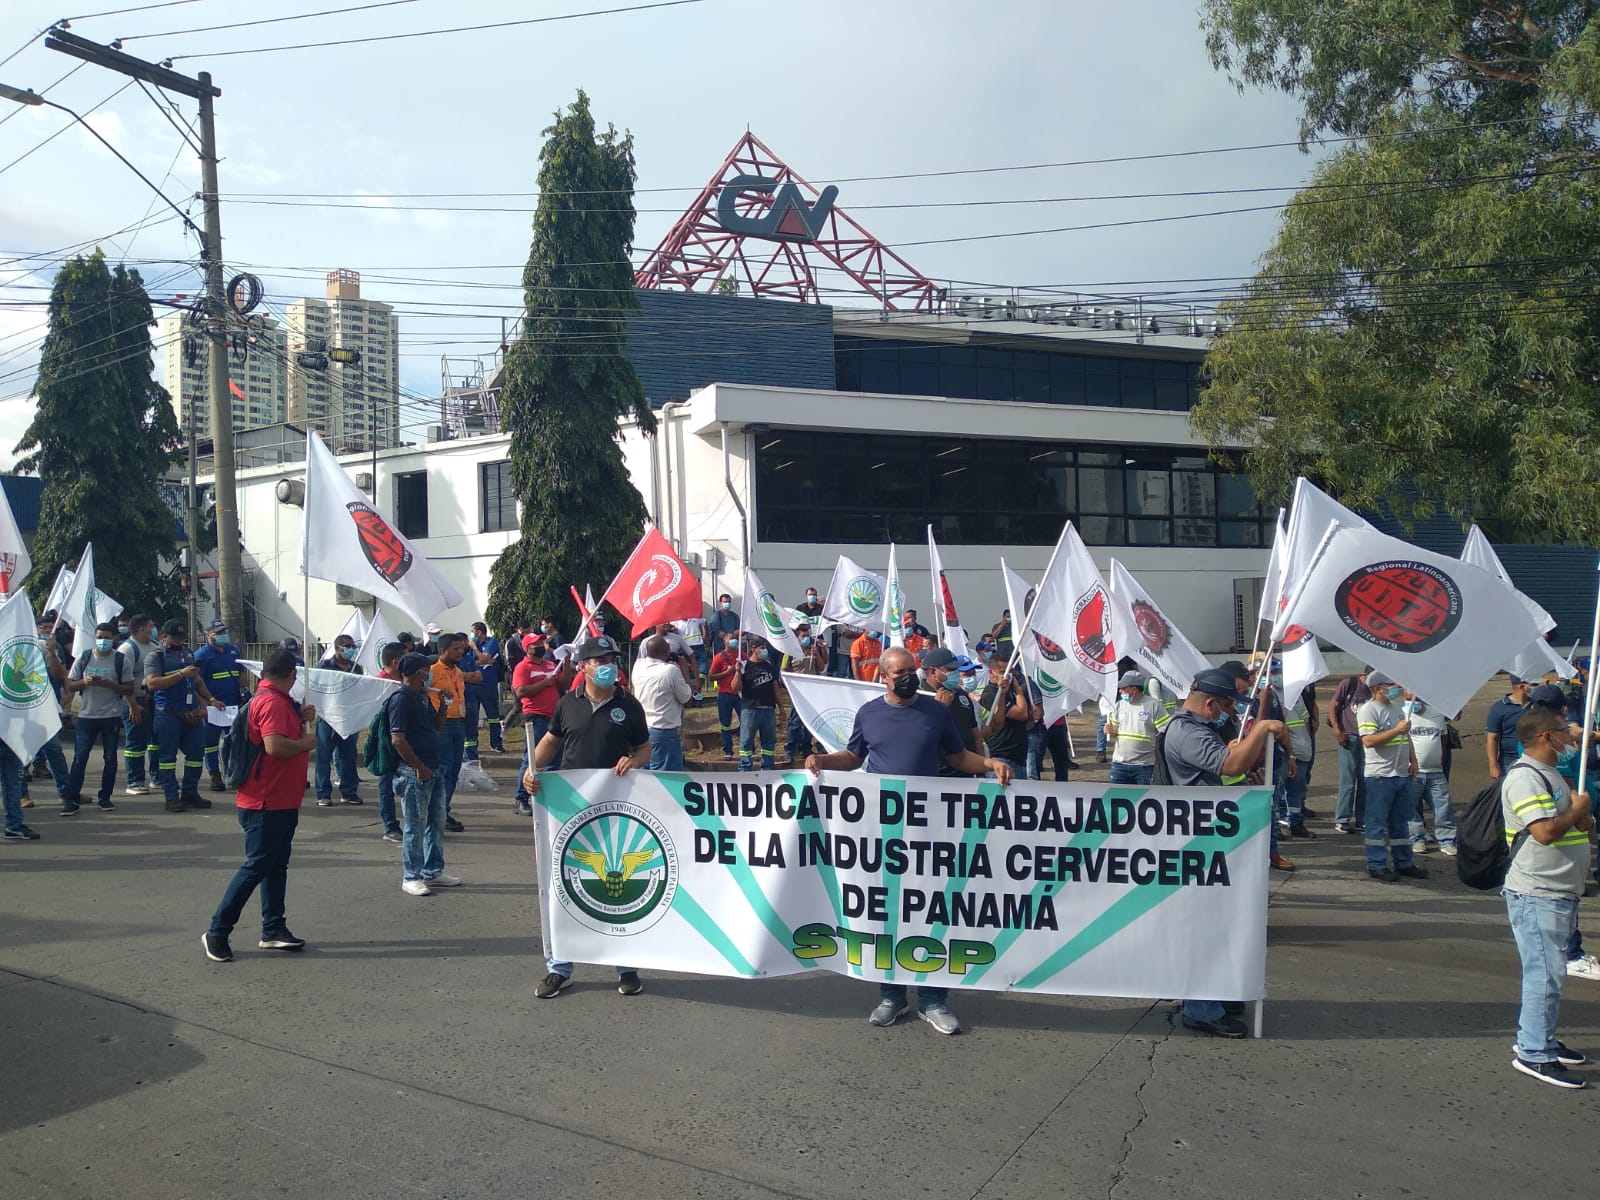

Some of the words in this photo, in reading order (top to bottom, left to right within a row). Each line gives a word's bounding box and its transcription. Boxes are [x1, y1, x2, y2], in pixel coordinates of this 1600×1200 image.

[1355, 578, 1439, 631] UITA
[1366, 562, 1411, 574] Regional
[1413, 564, 1459, 616] Latinoamericana
[1073, 642, 1105, 671] FUCLAT
[1343, 615, 1399, 650] rel-uita.org
[615, 803, 654, 824] INDUSTRIA
[683, 782, 865, 823] SINDICATO
[879, 789, 928, 827] DE
[940, 792, 1240, 837] TRABAJADORES
[694, 829, 736, 865] DE
[749, 831, 786, 868] LA
[799, 831, 993, 878] INDUSTRIA
[1005, 844, 1231, 887] CERVECERA
[842, 883, 889, 921] DE
[902, 885, 1059, 931] PANAMÁ
[792, 922, 997, 975] STICP
